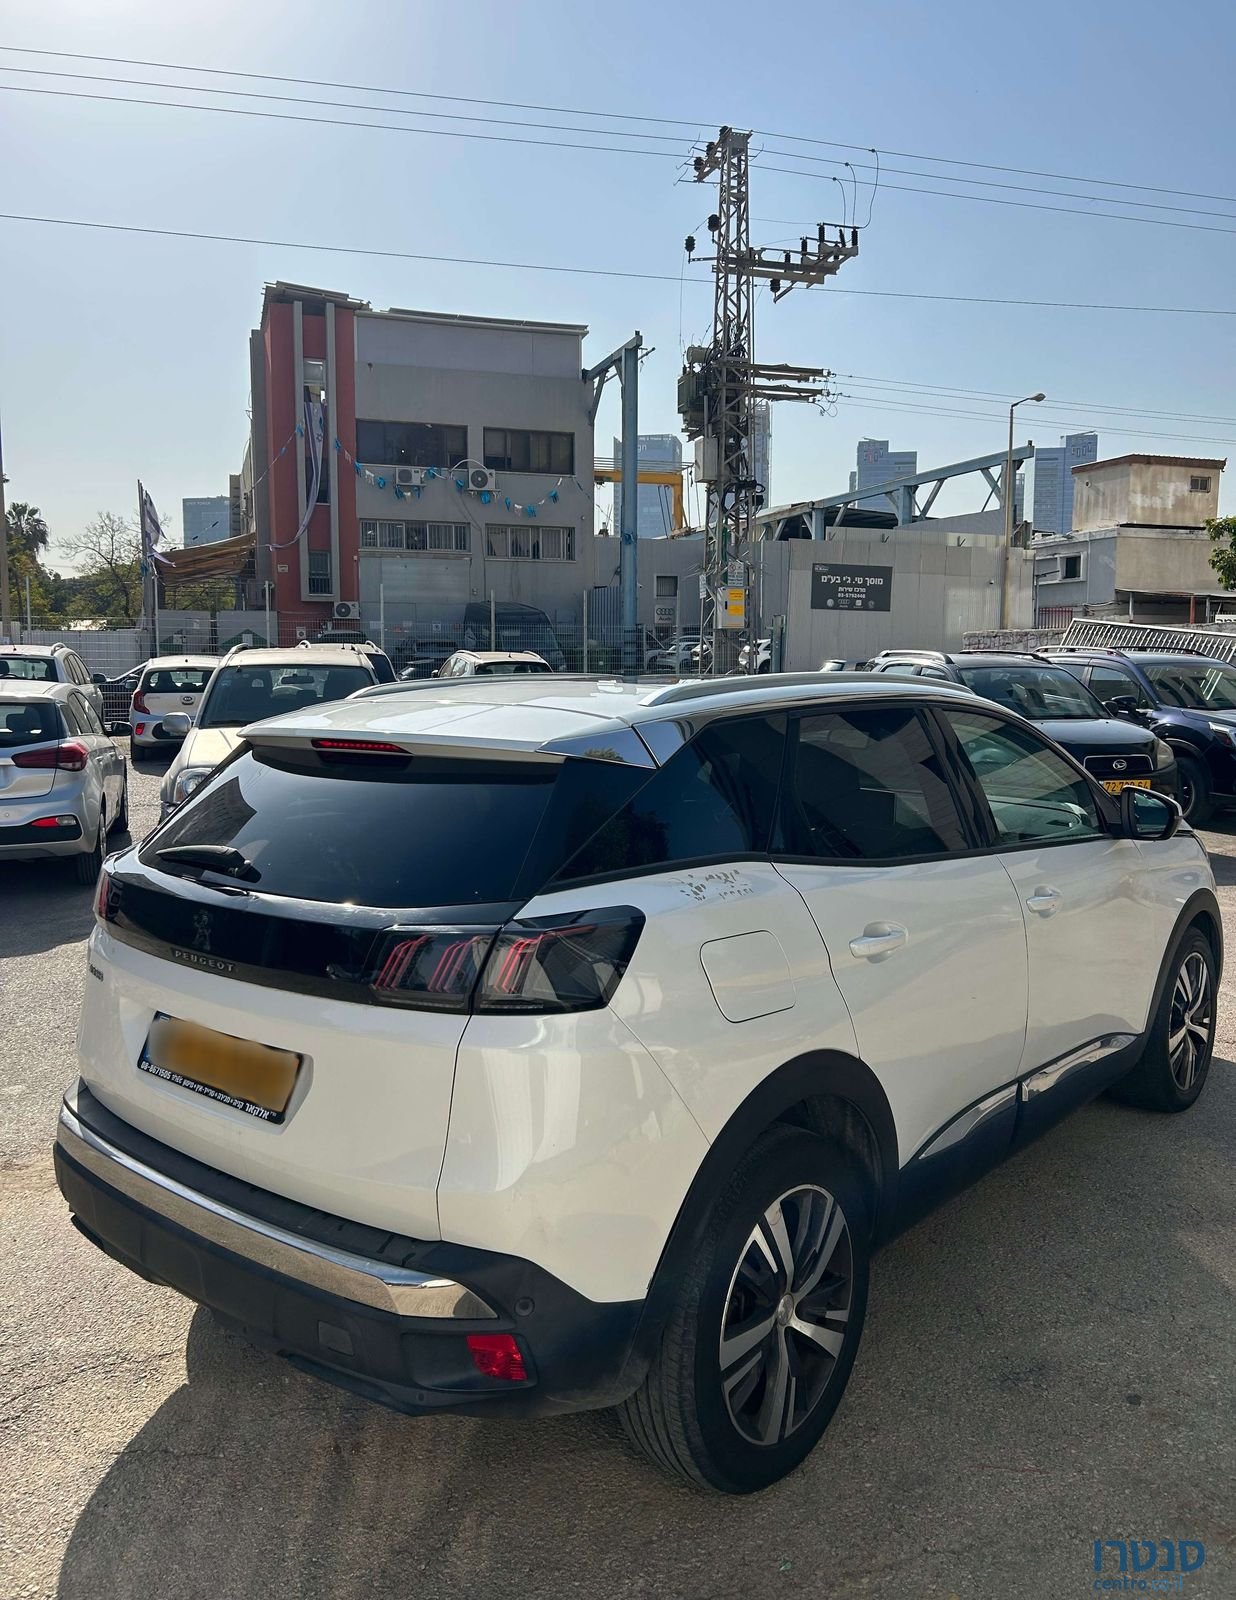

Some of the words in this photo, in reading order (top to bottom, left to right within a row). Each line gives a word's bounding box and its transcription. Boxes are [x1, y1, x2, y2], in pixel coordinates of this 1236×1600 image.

[865, 577, 884, 586] מוסך
[175, 950, 234, 972] PEUGEOT
[245, 1102, 270, 1120] אלקאר
